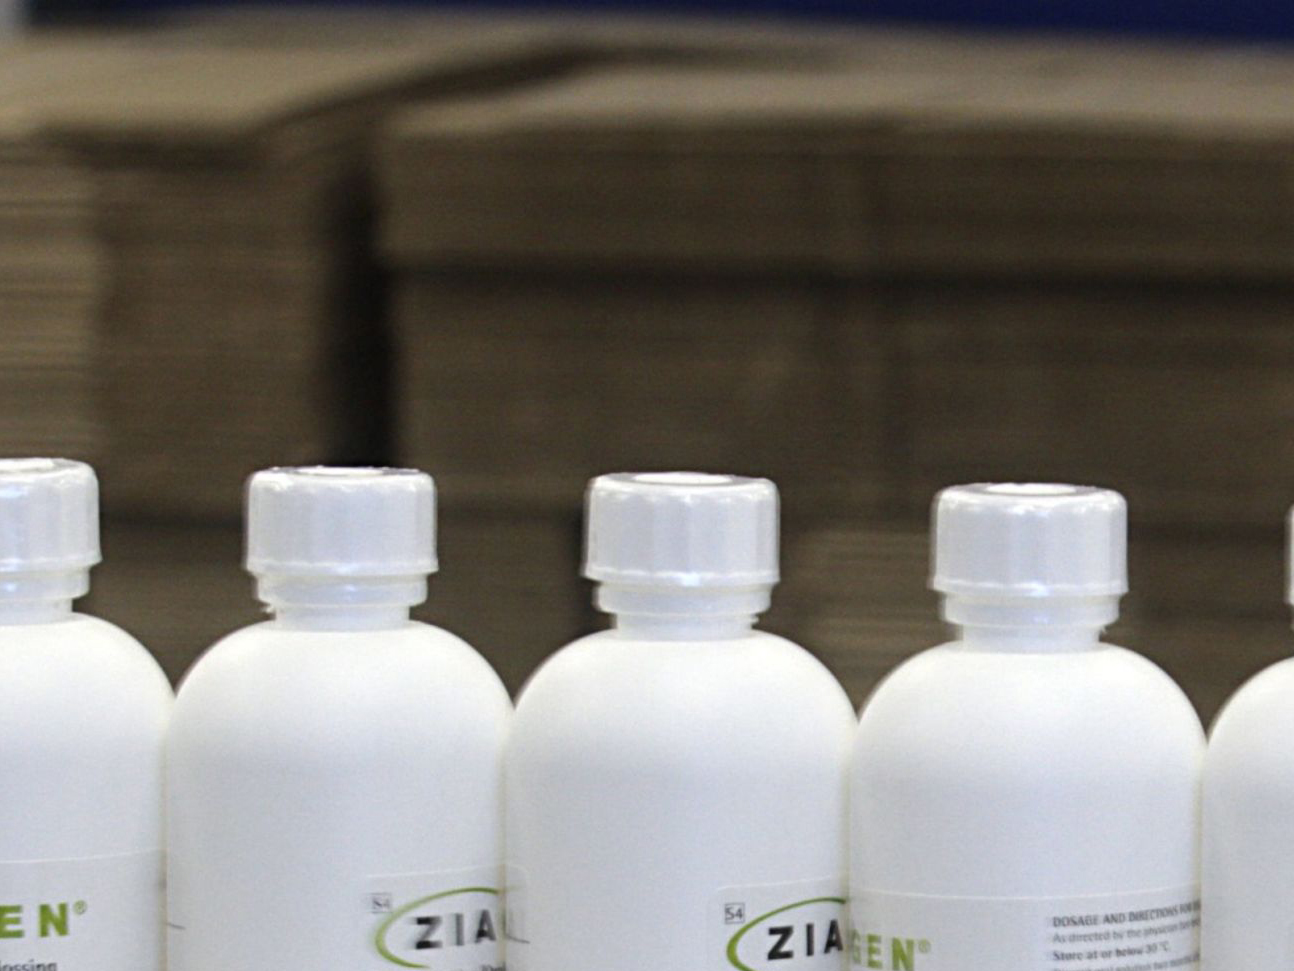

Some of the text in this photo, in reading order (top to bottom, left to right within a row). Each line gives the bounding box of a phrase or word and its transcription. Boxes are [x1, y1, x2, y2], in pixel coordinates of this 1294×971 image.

[414, 908, 497, 950] ZIA
[768, 919, 843, 961] ZIA
[1053, 913, 1098, 927] DOSAGE
[1103, 912, 1126, 924] AND
